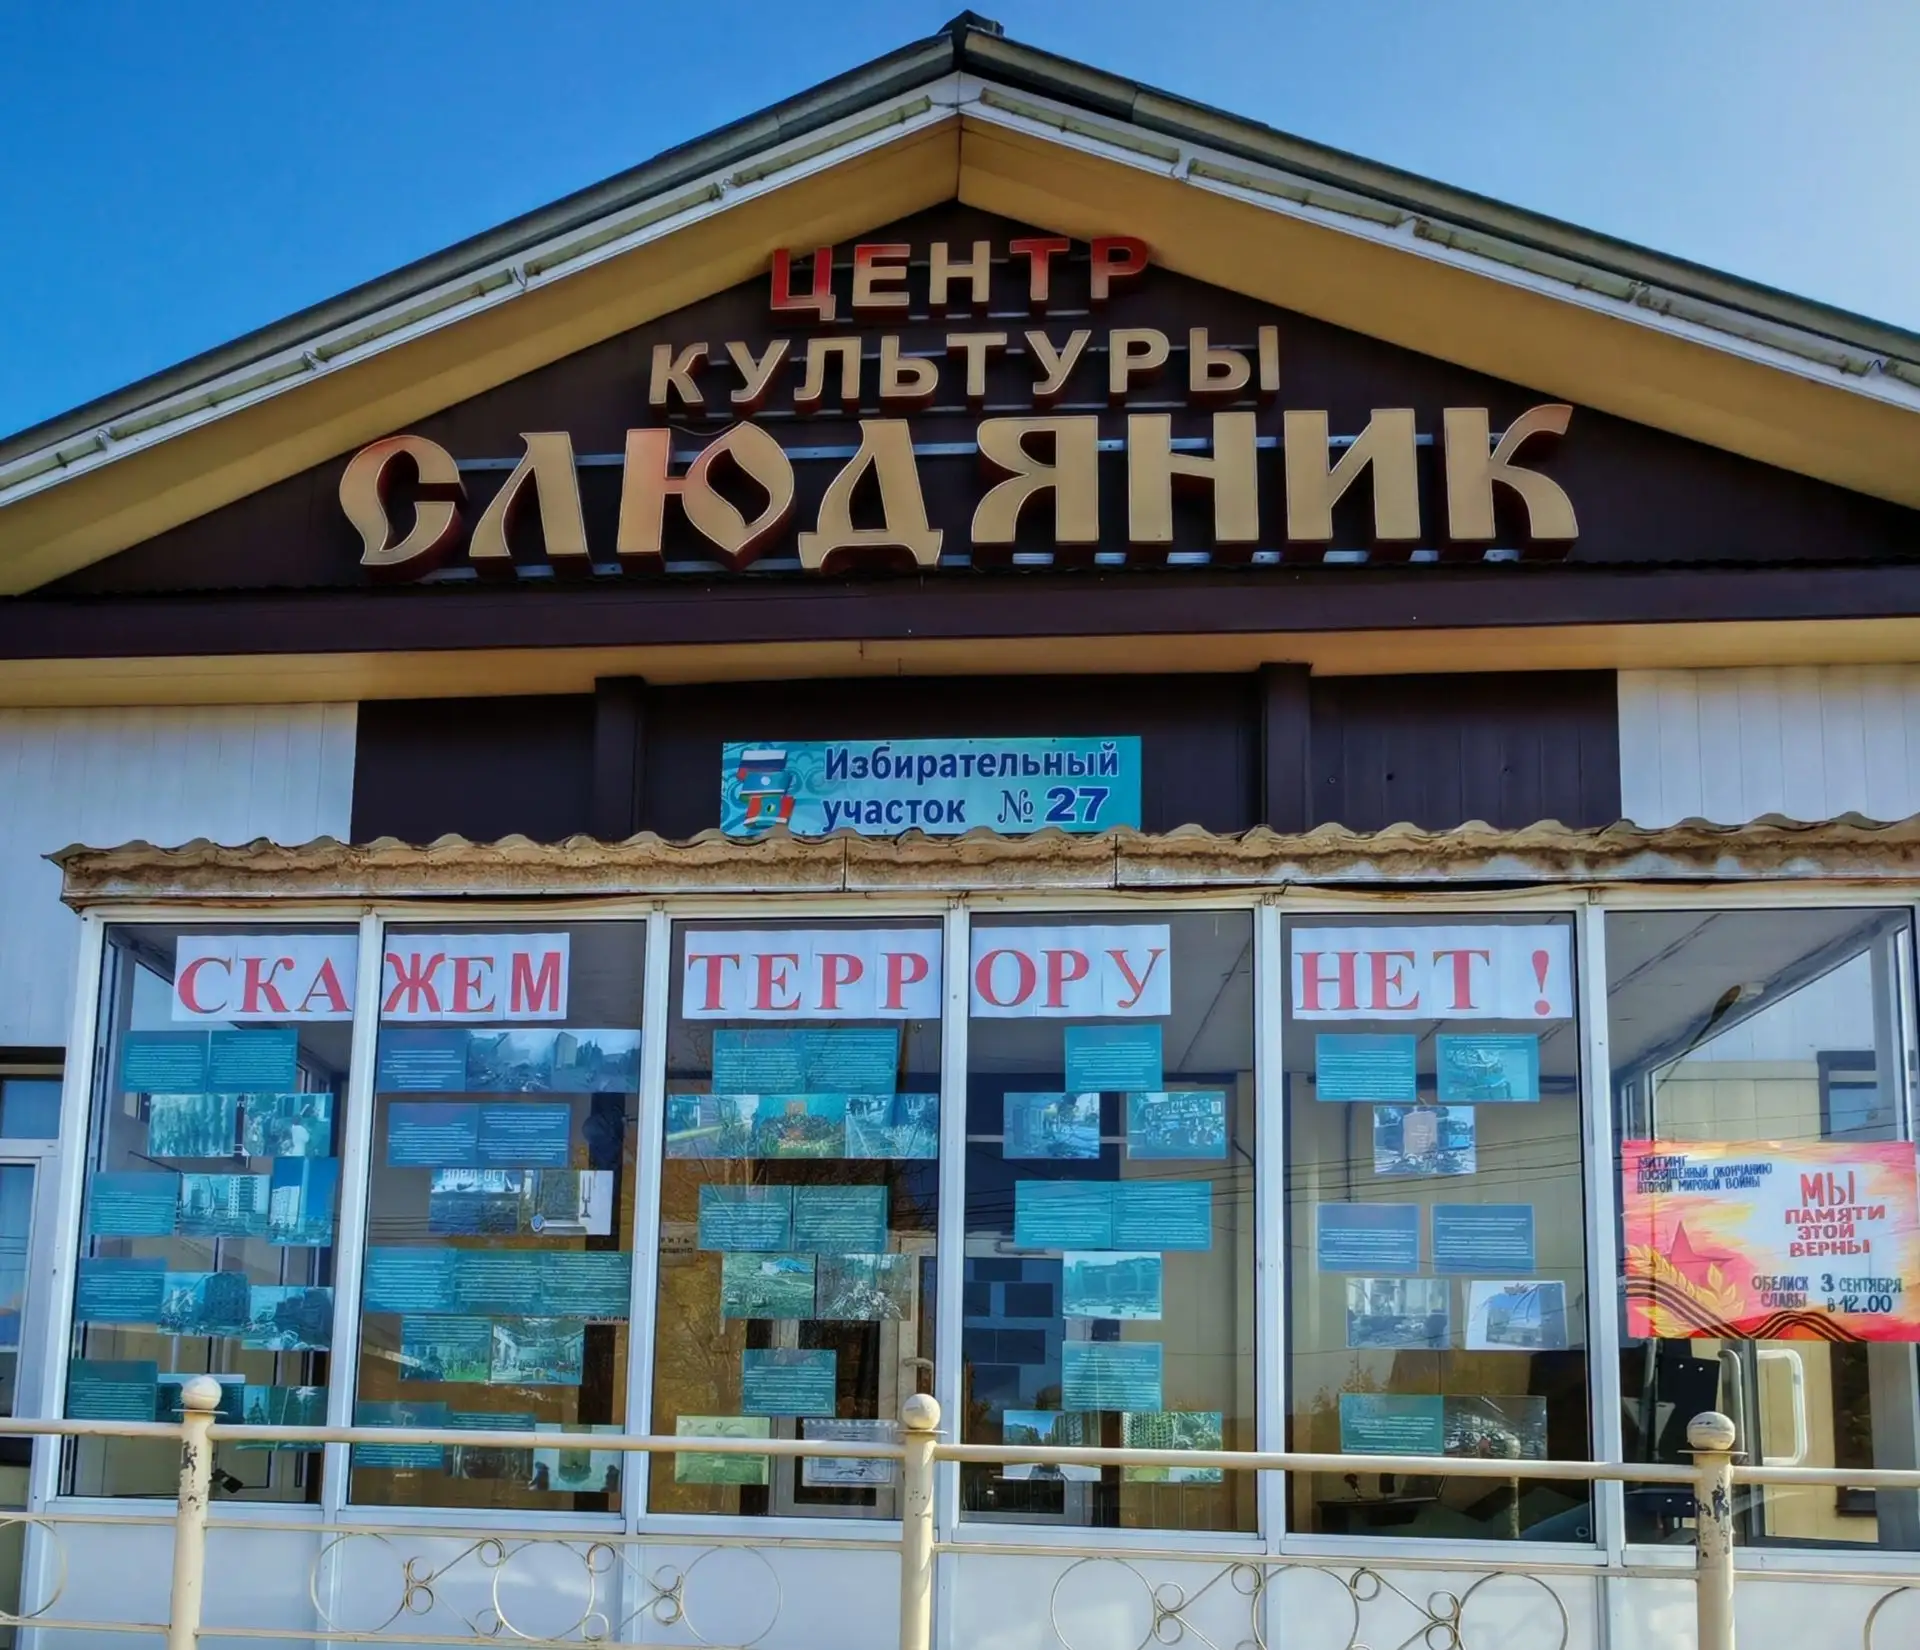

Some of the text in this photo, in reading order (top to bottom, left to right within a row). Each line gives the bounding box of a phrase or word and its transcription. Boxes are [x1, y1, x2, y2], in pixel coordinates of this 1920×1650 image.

[771, 237, 1148, 321] ЦЕНТР
[649, 325, 1281, 405] КУЛЬТУРЫ
[339, 405, 1579, 572] СЛЮДЯНИК
[824, 741, 1120, 786] Избирательный
[822, 785, 1111, 833] участок № 27
[176, 951, 563, 1014] СКАЖЕМ
[687, 948, 1167, 1012] ТЕРРОРУ
[1636, 1155, 1688, 1169] МИТИНГ
[1712, 1162, 1773, 1178] ОКОНЧАНИЮ
[1636, 1175, 1761, 1194] ВТОРОЙ МИРОВОЙ ВОЙНЫ
[1800, 1170, 1855, 1208] МЫ
[1784, 1204, 1886, 1225] ПАМЯТИ
[1797, 1222, 1855, 1241] ЭТОЙ
[1789, 1239, 1871, 1258] ВЕРНЫ
[1751, 1275, 1809, 1291] ОБЕЛИСК
[1820, 1273, 1903, 1293] 3 СЕНТЯБРЯ
[1760, 1292, 1807, 1309] СЛАВЫ
[1838, 1294, 1893, 1314] 12.00
